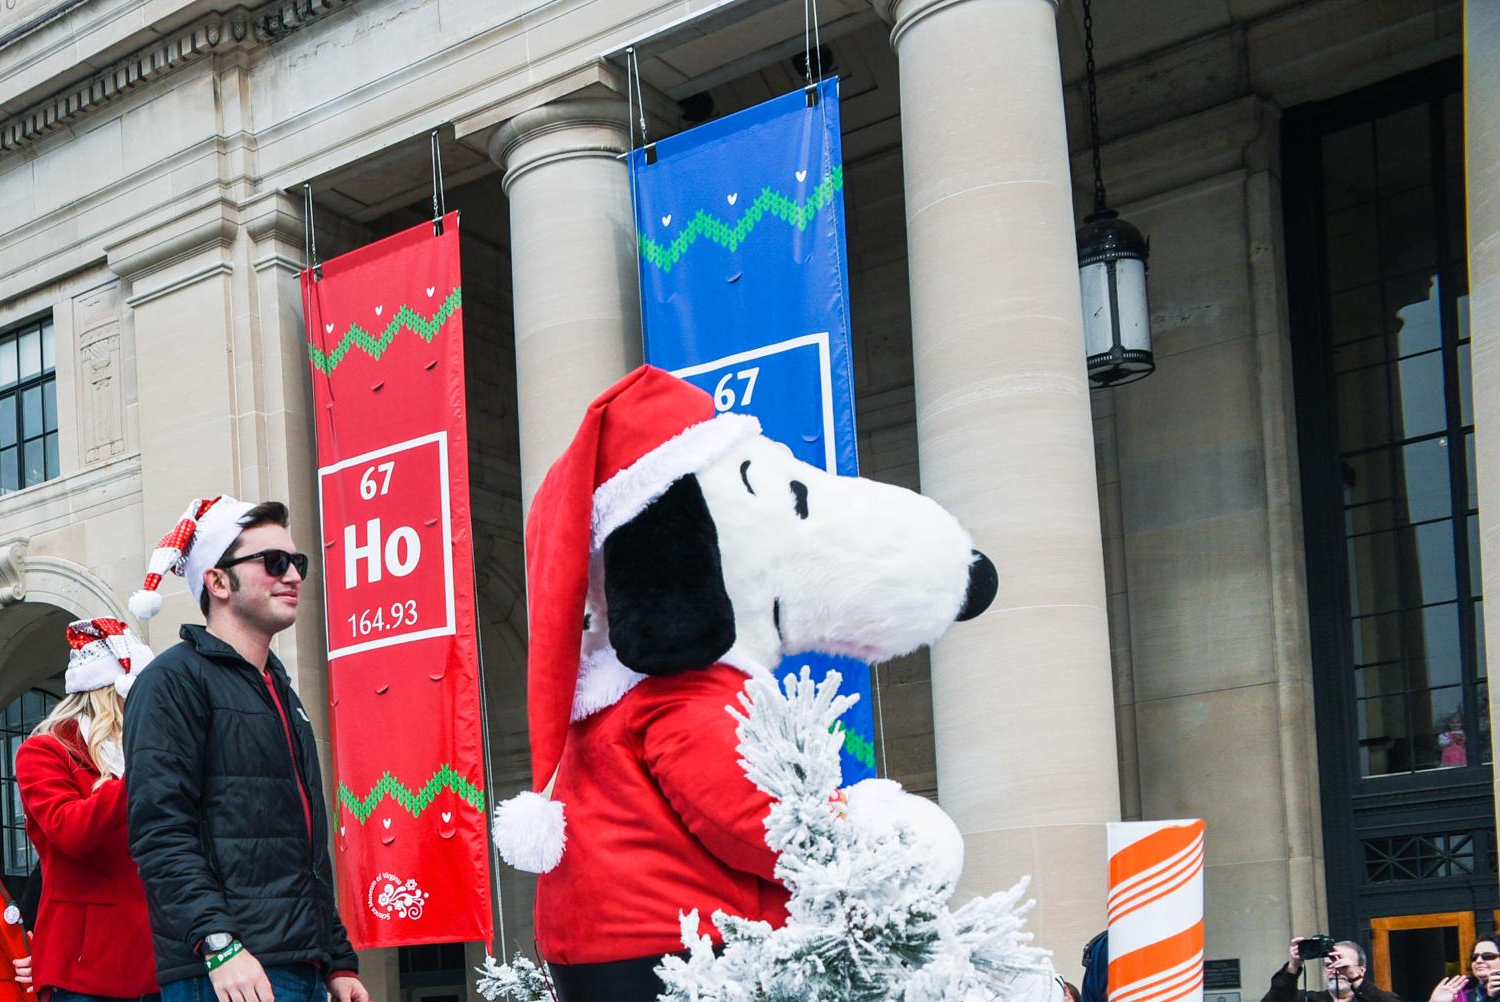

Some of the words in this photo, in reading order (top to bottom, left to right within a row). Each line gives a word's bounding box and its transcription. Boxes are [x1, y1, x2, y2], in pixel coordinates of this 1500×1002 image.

[714, 367, 760, 412] 67
[359, 461, 395, 500] 67
[344, 517, 421, 590] Ho
[347, 599, 419, 638] 164.93
[368, 880, 376, 908] Museum
[383, 872, 402, 885] Virginia
[372, 907, 391, 920] Science
